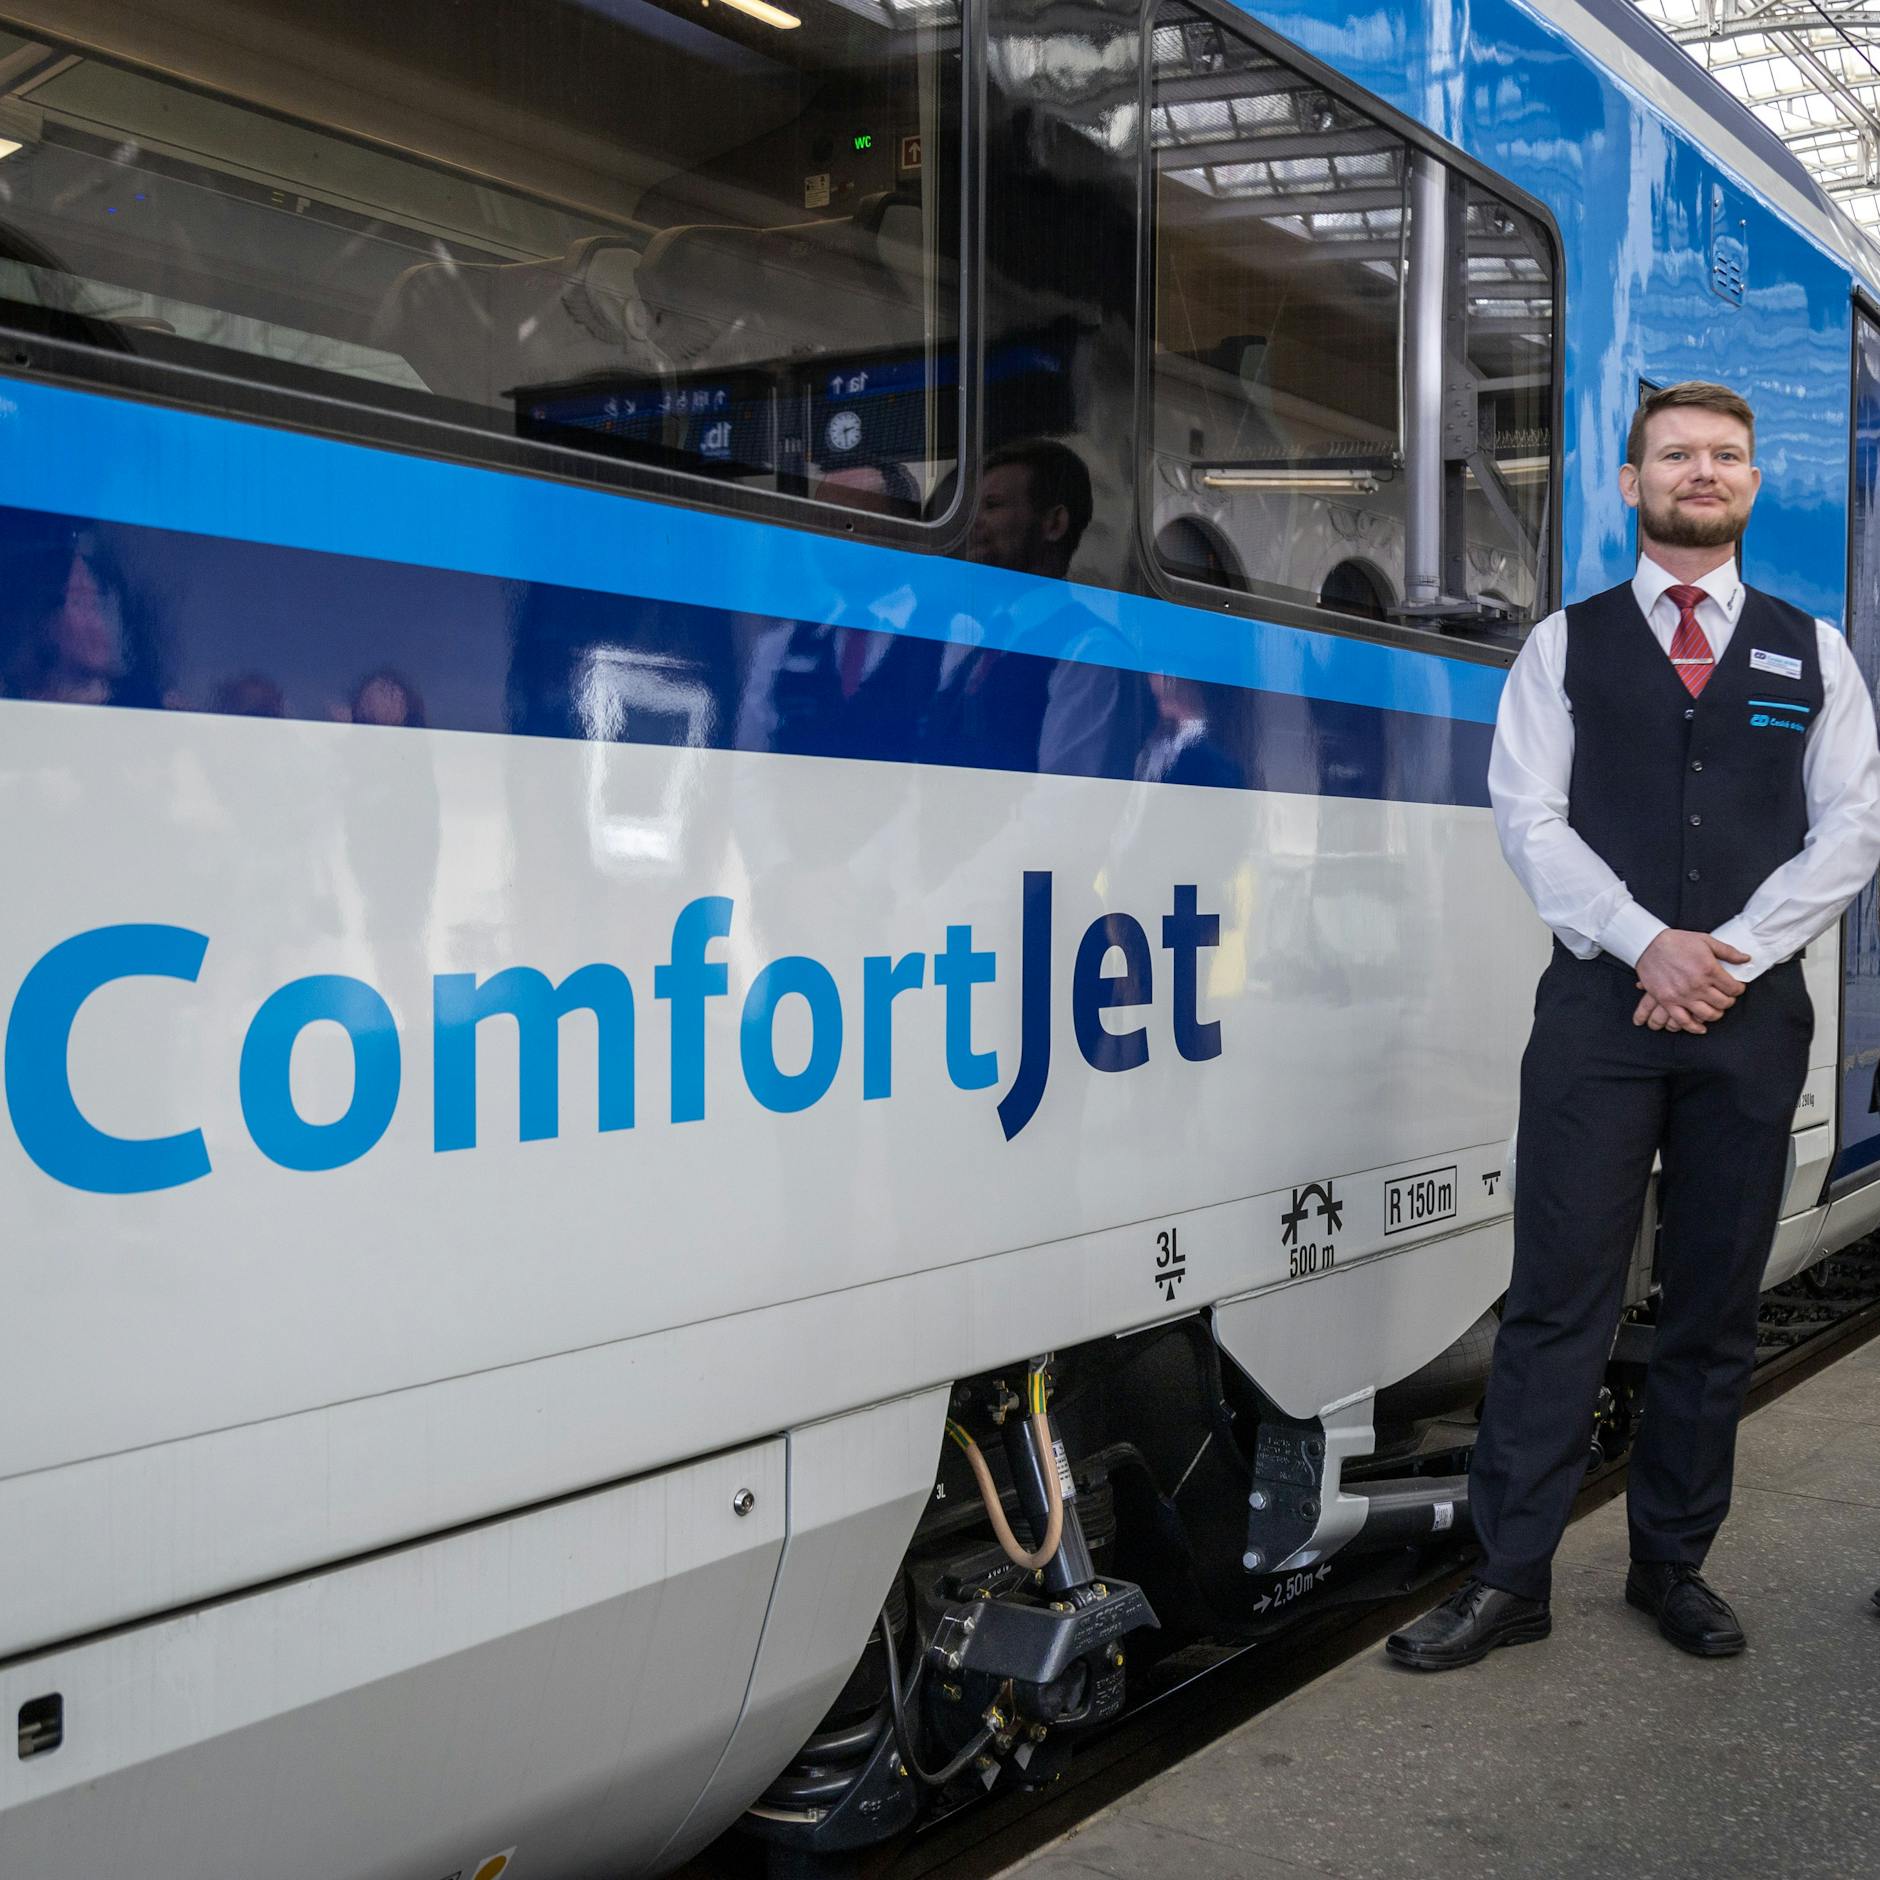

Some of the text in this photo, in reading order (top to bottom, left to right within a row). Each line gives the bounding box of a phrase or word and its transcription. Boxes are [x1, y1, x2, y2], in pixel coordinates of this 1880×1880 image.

[854, 135, 871, 149] WC
[4, 871, 1222, 1194] ComfortJet
[1390, 1188, 1401, 1225] R
[1156, 1227, 1186, 1268] 3L
[1290, 1243, 1335, 1278] 500 m
[936, 1483, 946, 1500] 3L
[1273, 1572, 1314, 1608] 2,50m
